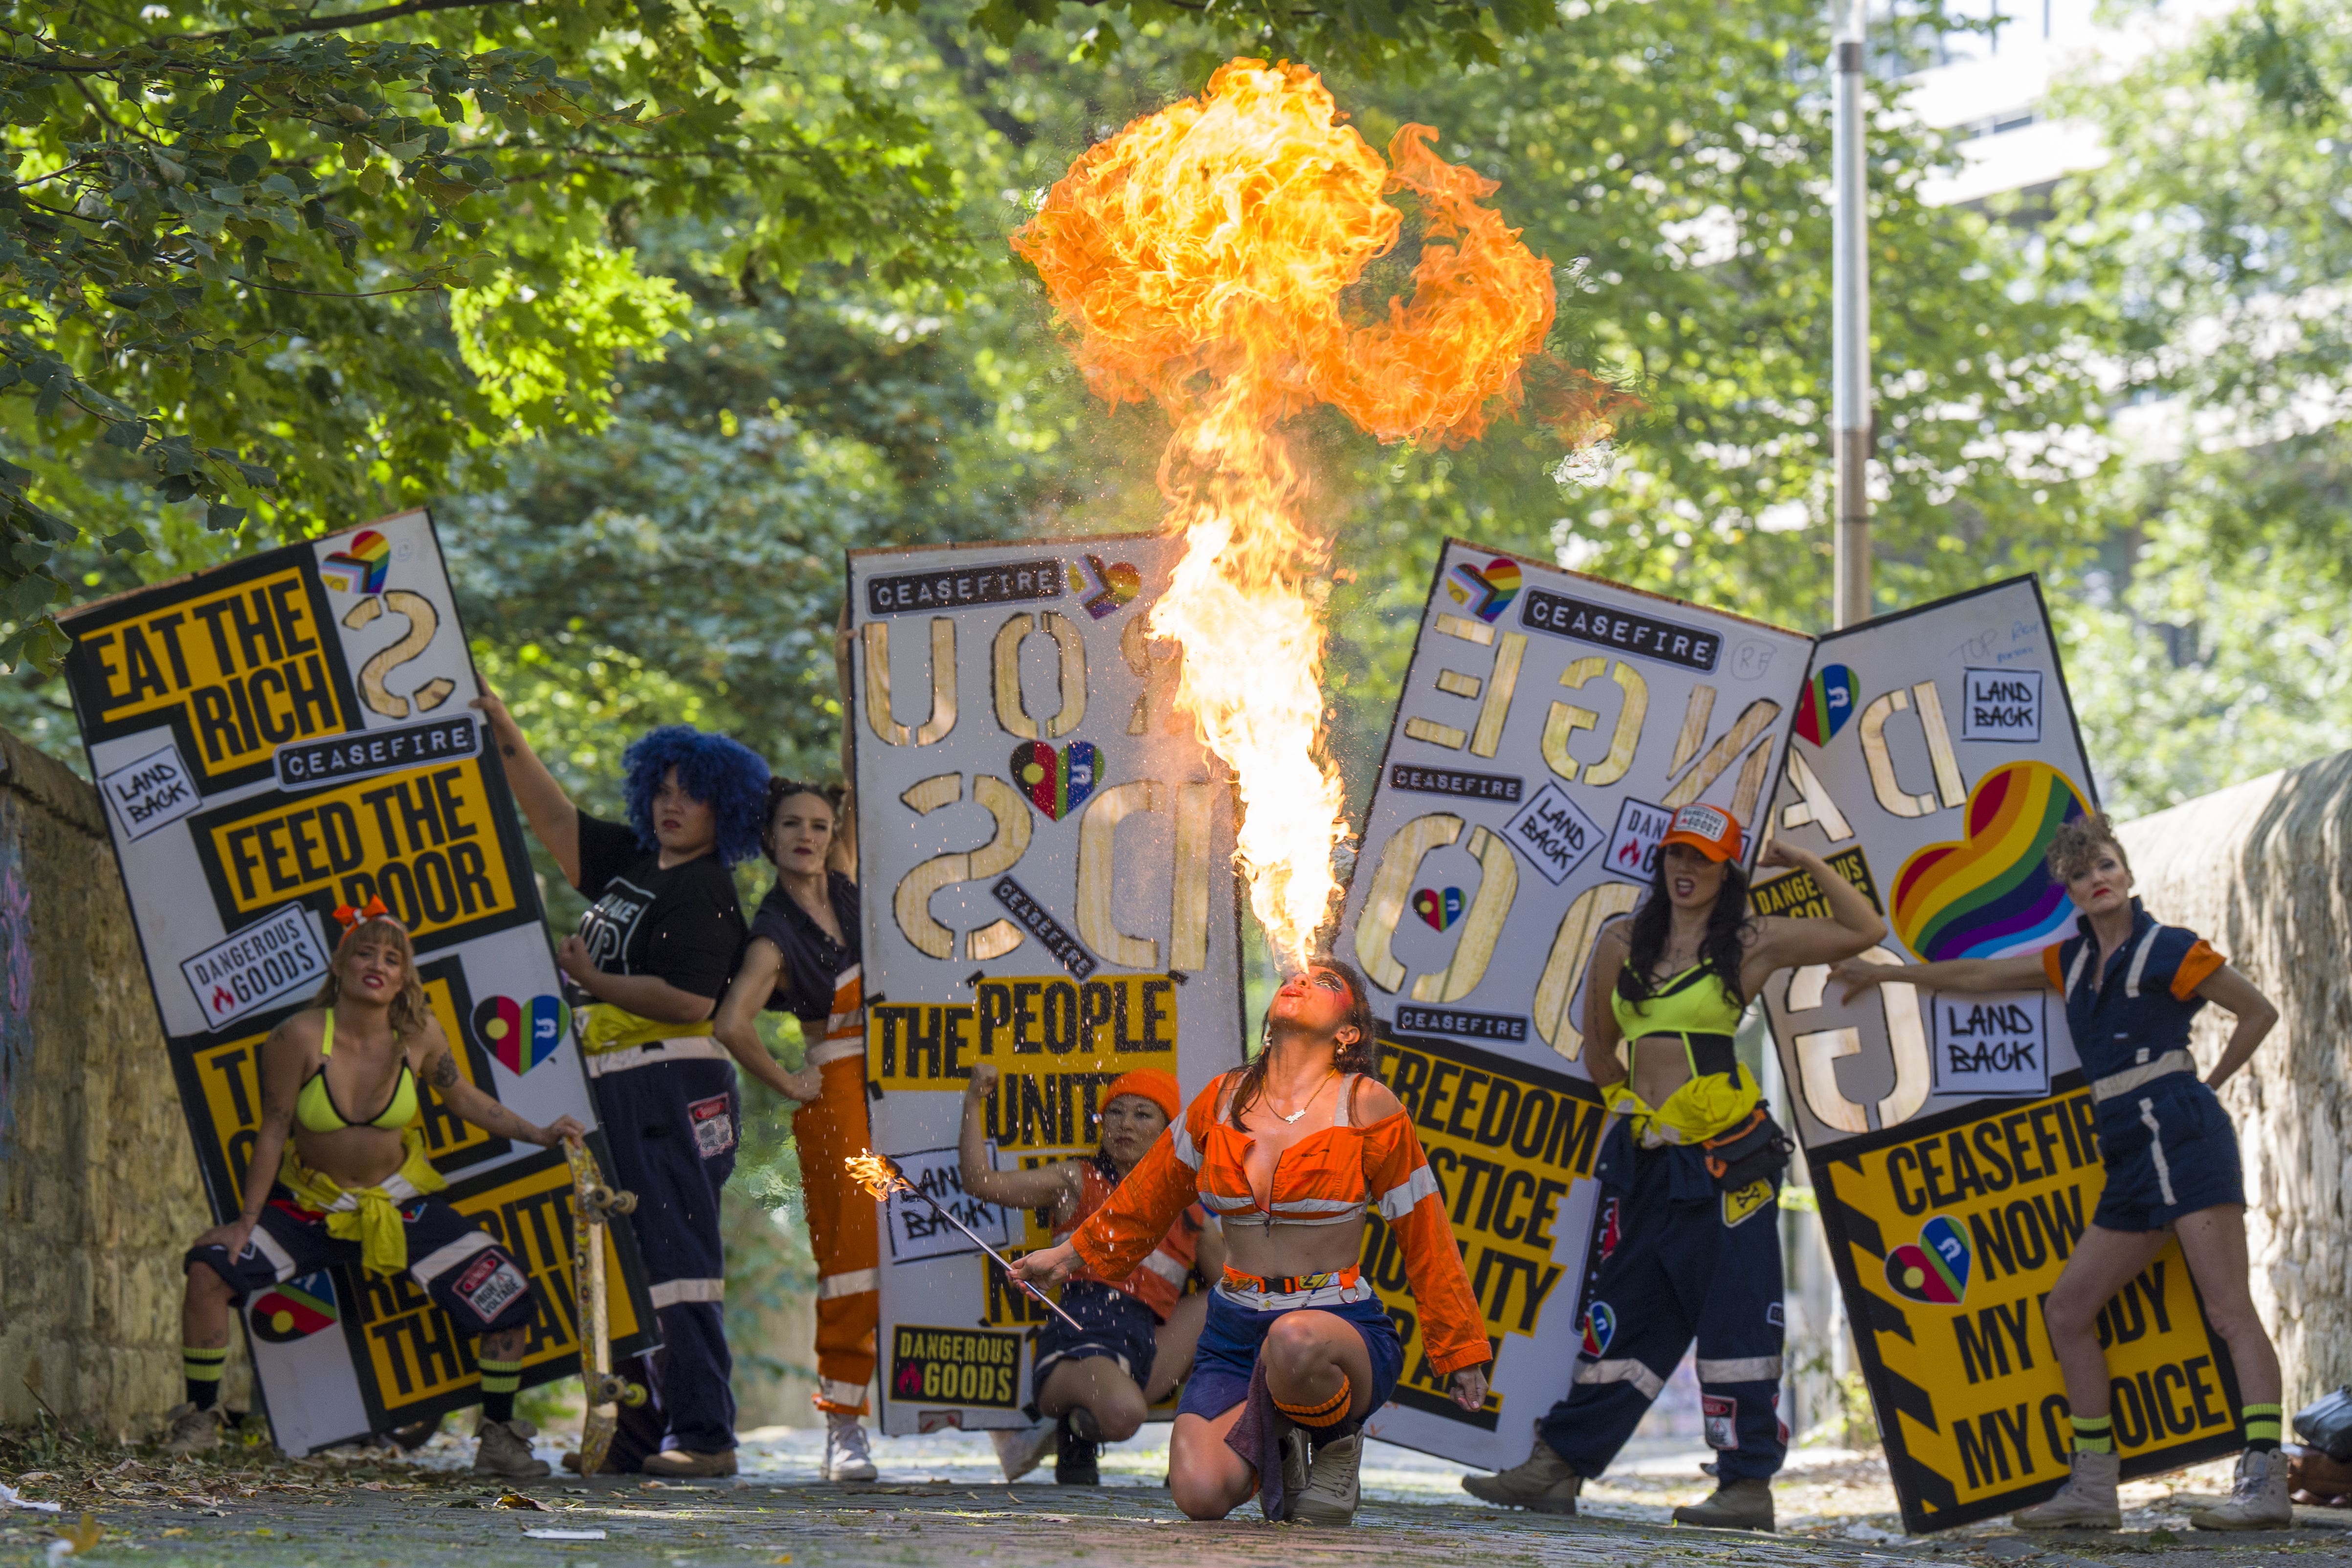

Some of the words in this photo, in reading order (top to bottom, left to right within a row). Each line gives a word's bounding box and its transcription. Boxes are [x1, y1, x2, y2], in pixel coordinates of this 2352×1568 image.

[877, 569, 1054, 609] CEASEFIRE
[81, 610, 196, 710] EAT
[194, 578, 319, 677] THE
[1531, 600, 1711, 663] CEASEFIRE
[191, 654, 338, 764] RICH
[1975, 681, 2032, 704] LAND
[1975, 706, 2034, 728] BACK
[288, 726, 471, 778] CEASEFIRE
[117, 760, 178, 803] LAND
[126, 781, 192, 824] BACK
[1396, 771, 1518, 799] CEASEFIRE
[226, 801, 365, 903] FEED
[361, 768, 478, 859] THE
[1519, 815, 1574, 870] BACK
[1537, 797, 1585, 851] LAND
[194, 918, 302, 985] DANGEROUS
[998, 882, 1093, 974] CEASEFIRE
[232, 942, 316, 1004] GOODS
[875, 1007, 975, 1078] THE
[980, 980, 1172, 1056] PEOPLE
[1401, 1010, 1523, 1037] CEASEFIRE
[1948, 1005, 2034, 1037] LAND
[1948, 1041, 2037, 1075] BACK
[1886, 1096, 2104, 1217] CEASEFIR
[901, 1198, 995, 1239] BACK
[1968, 1184, 2086, 1282] NOW
[900, 1332, 1014, 1365] DANGEROUS
[1952, 1294, 2034, 1385] MY
[923, 1365, 1013, 1402] GOODS
[1952, 1403, 2035, 1489] MY
[2040, 1355, 2227, 1466] COICE
